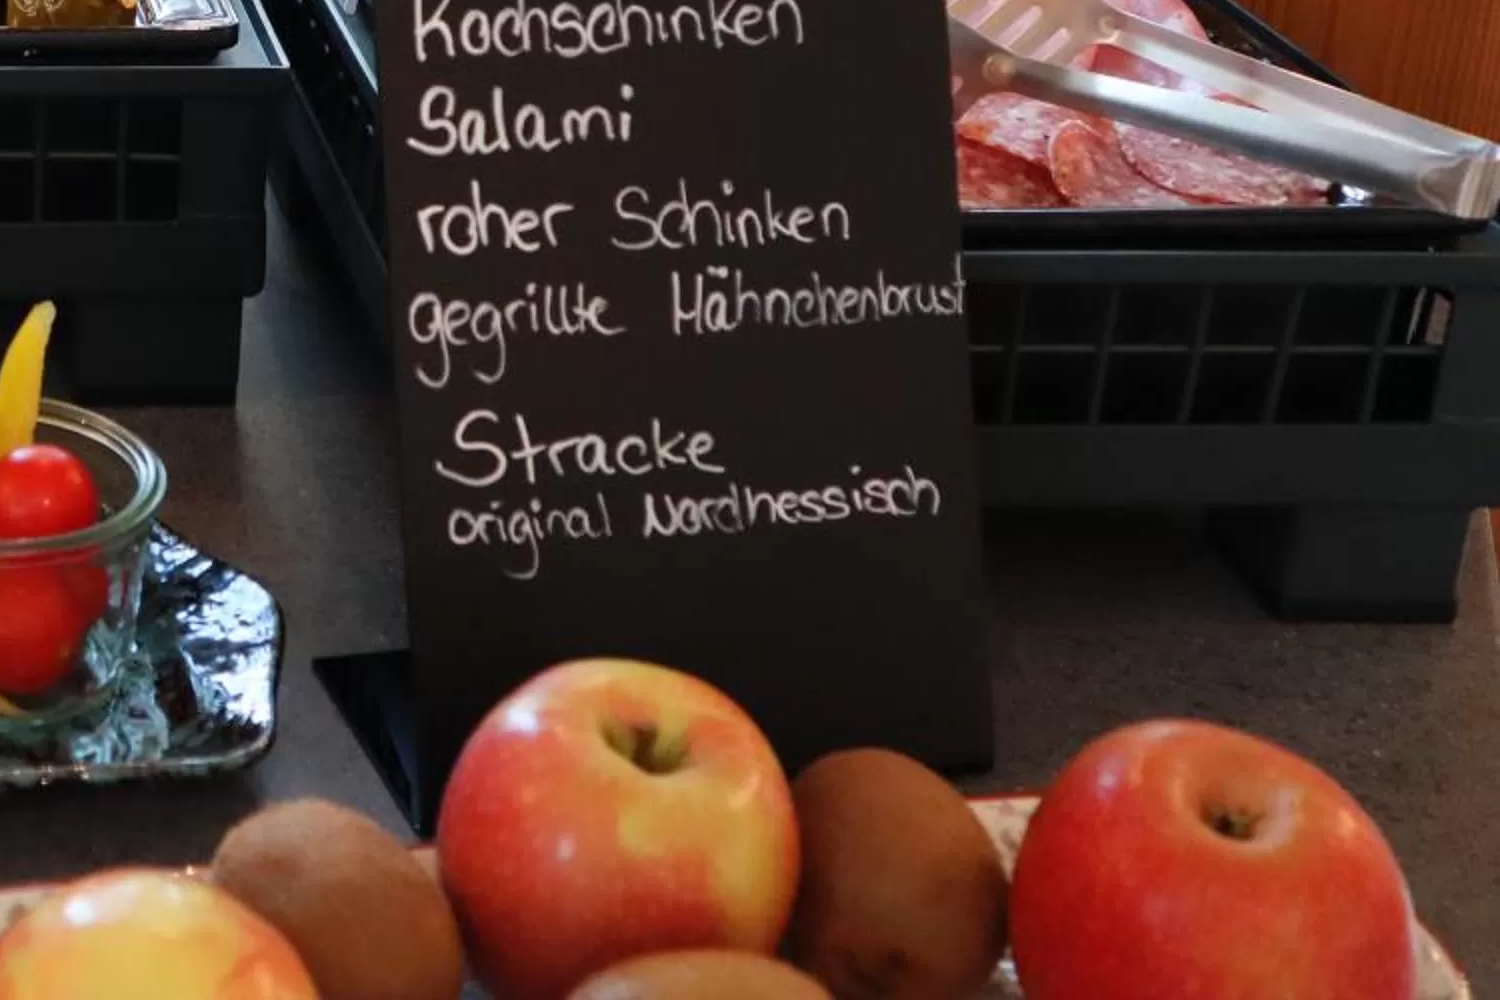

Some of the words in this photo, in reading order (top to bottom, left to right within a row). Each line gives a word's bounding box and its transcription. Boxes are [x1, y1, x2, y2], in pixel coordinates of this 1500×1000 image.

[406, 84, 634, 156] Salami
[417, 179, 574, 256] roher
[612, 179, 849, 250] Schinken
[408, 282, 626, 388] gegrillte
[669, 252, 967, 336] Hähnchenbrust
[436, 409, 724, 487] Stracke
[448, 494, 612, 579] original
[642, 465, 941, 538] Nordhessisch
